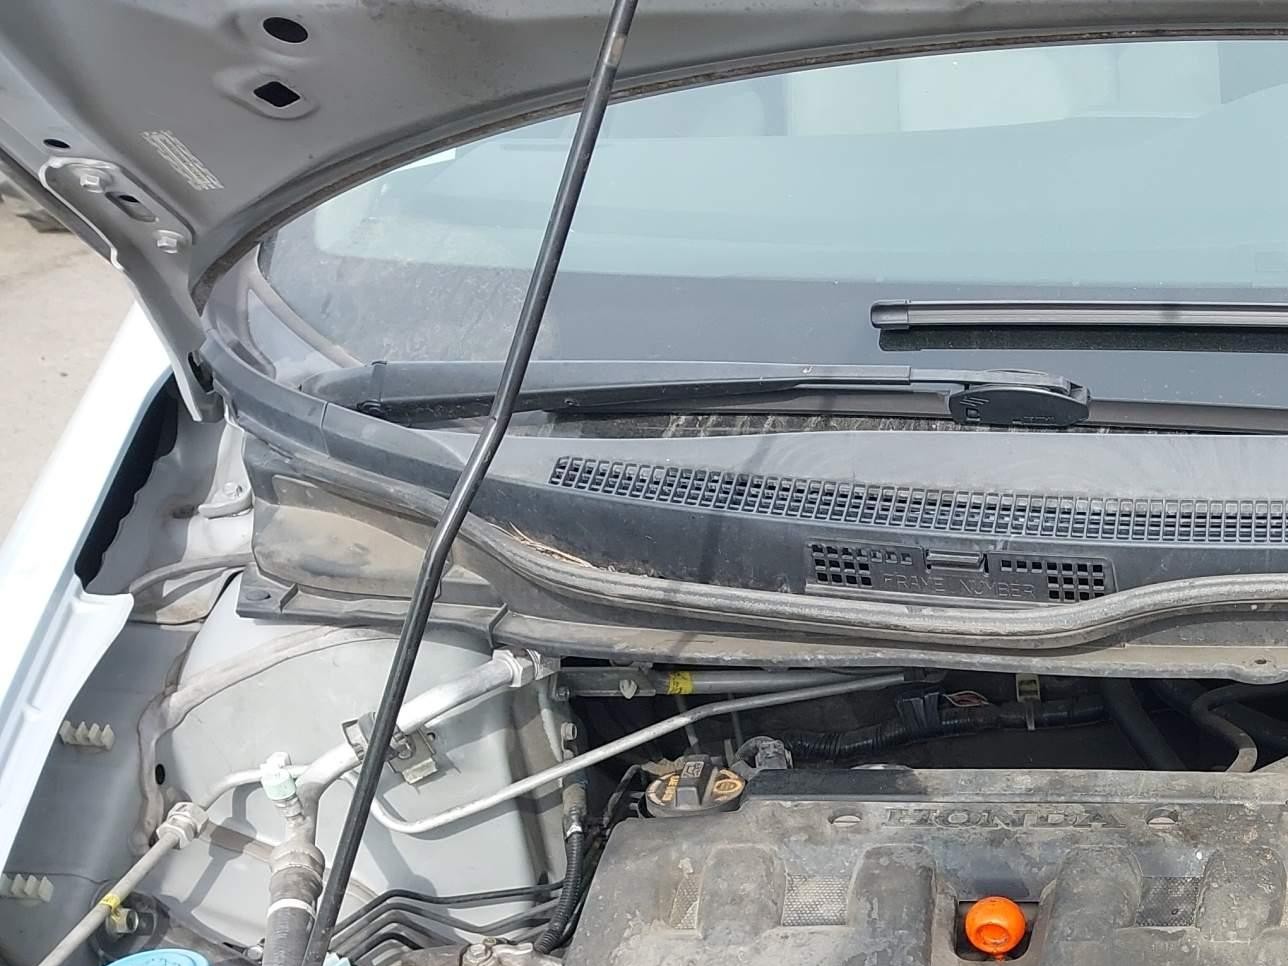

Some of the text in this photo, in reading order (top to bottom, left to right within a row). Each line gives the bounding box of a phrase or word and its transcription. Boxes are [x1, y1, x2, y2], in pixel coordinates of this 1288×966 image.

[883, 573, 1036, 600] FRAME NUMBER
[881, 807, 1128, 830] HONDA
